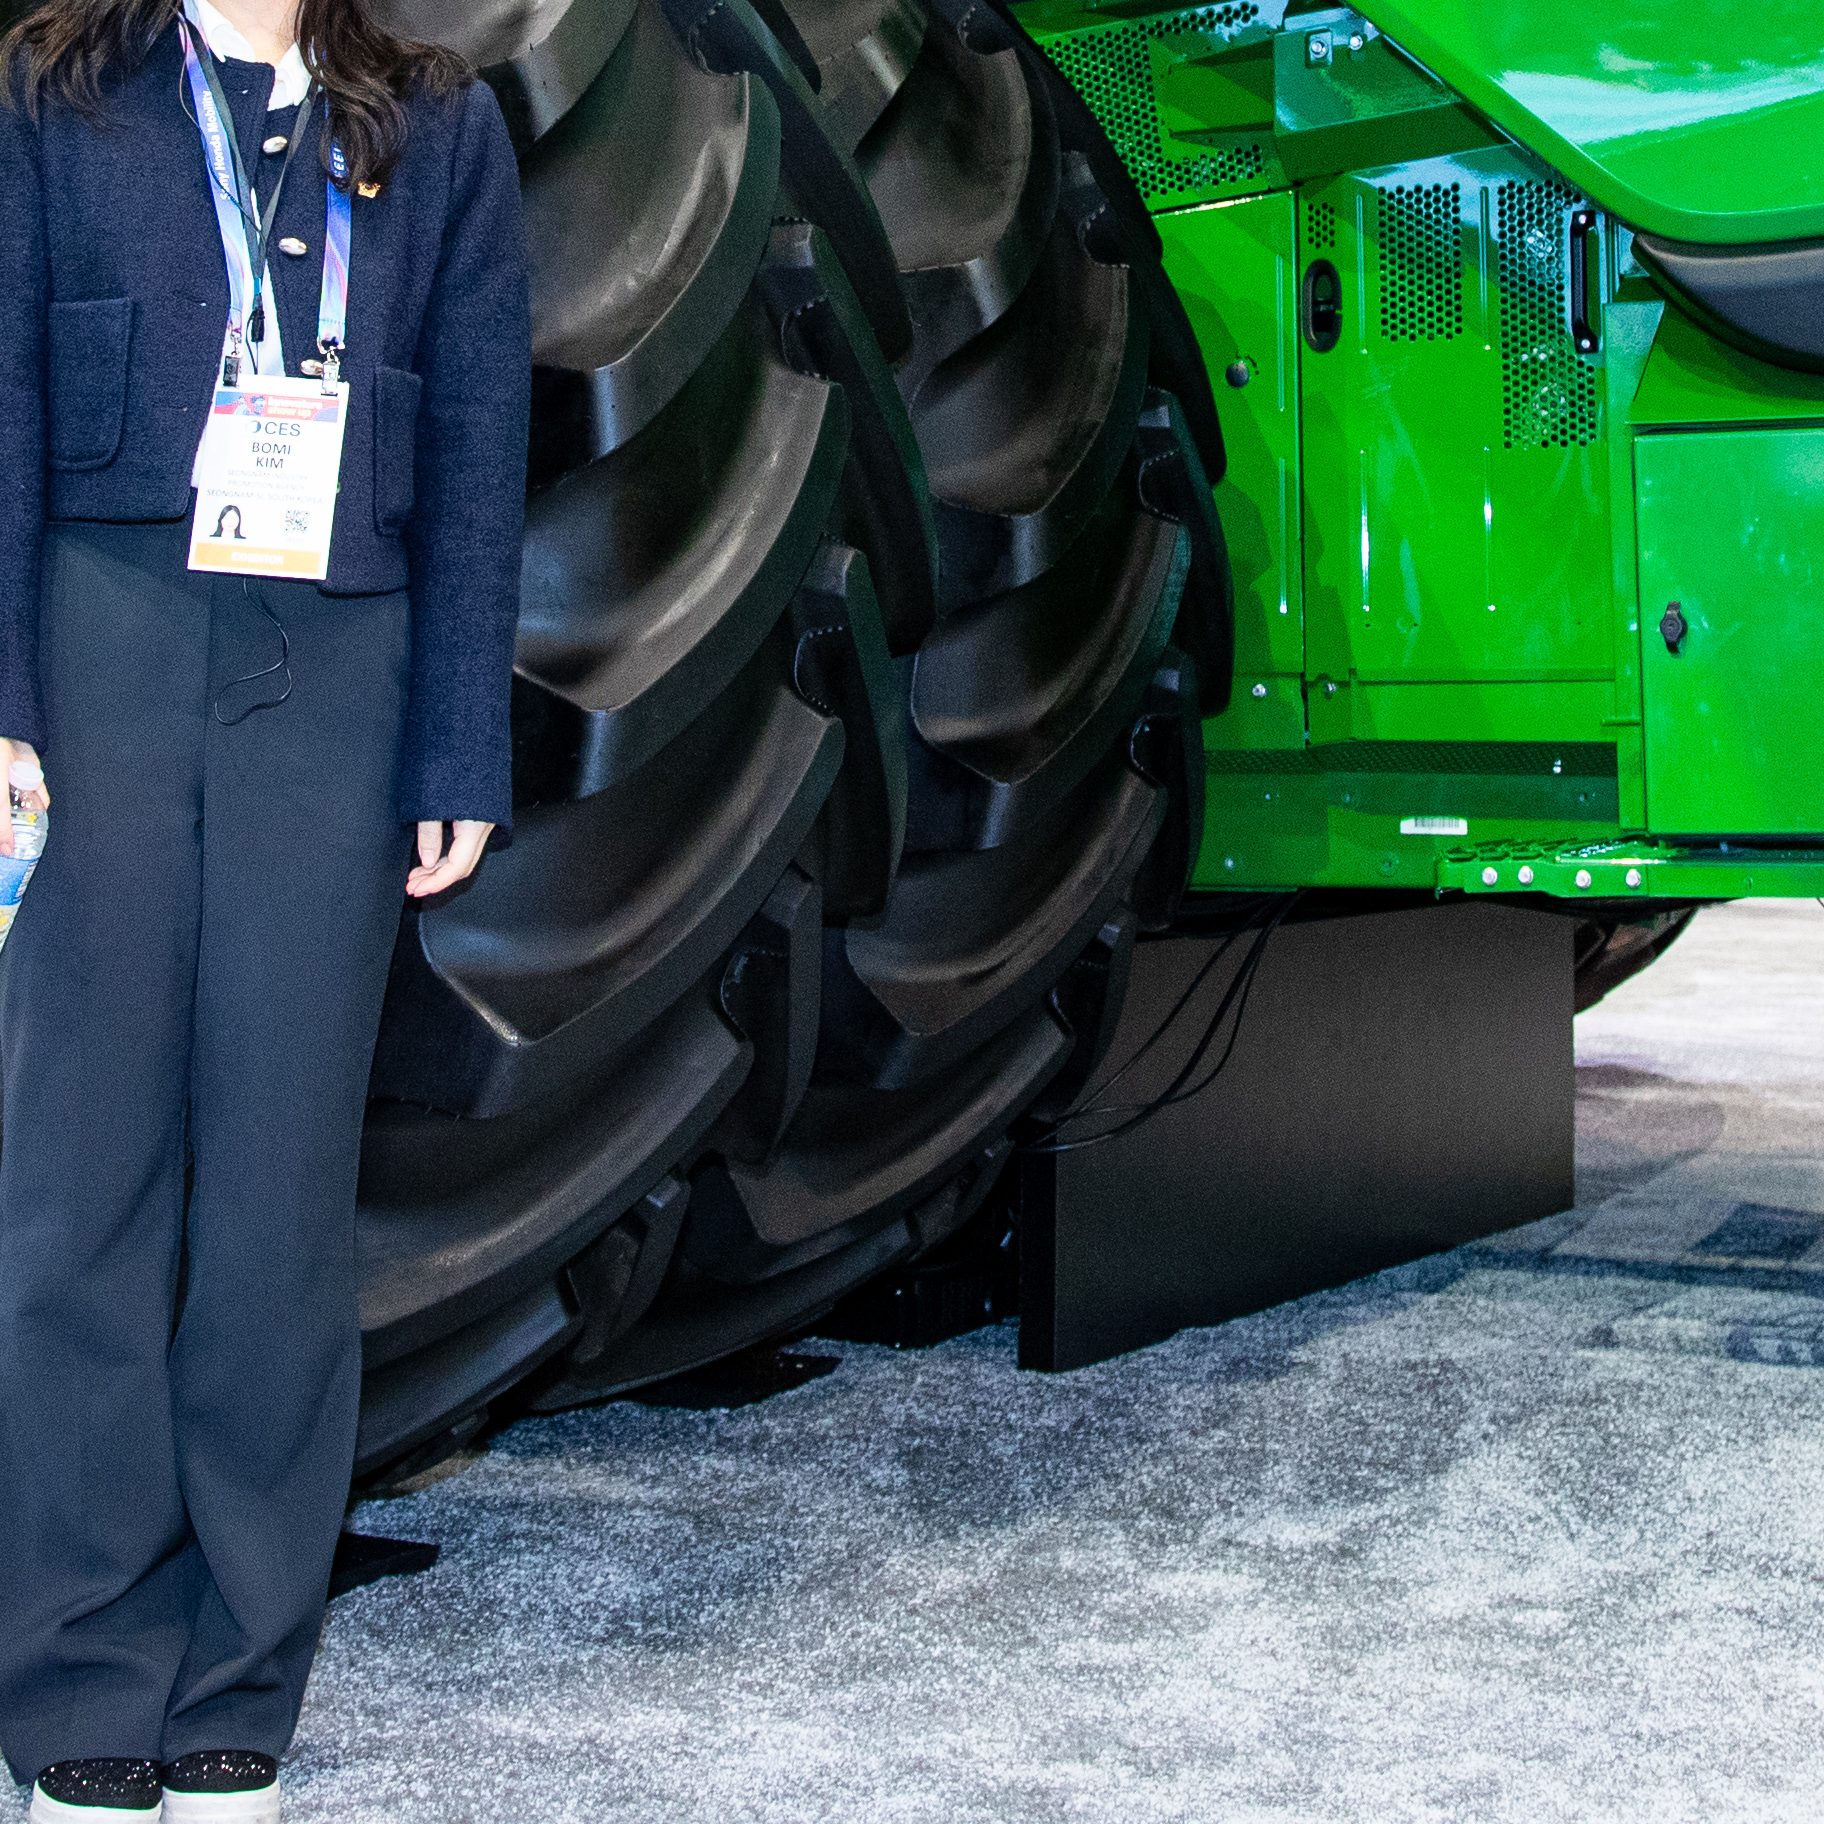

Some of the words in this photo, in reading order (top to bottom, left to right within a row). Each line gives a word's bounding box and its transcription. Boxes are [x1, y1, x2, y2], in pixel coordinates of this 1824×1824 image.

[203, 90, 218, 133] Mobility
[210, 135, 226, 171] Honda
[265, 421, 301, 437] CES
[252, 442, 292, 455] BOMI
[256, 457, 284, 469] KIM
